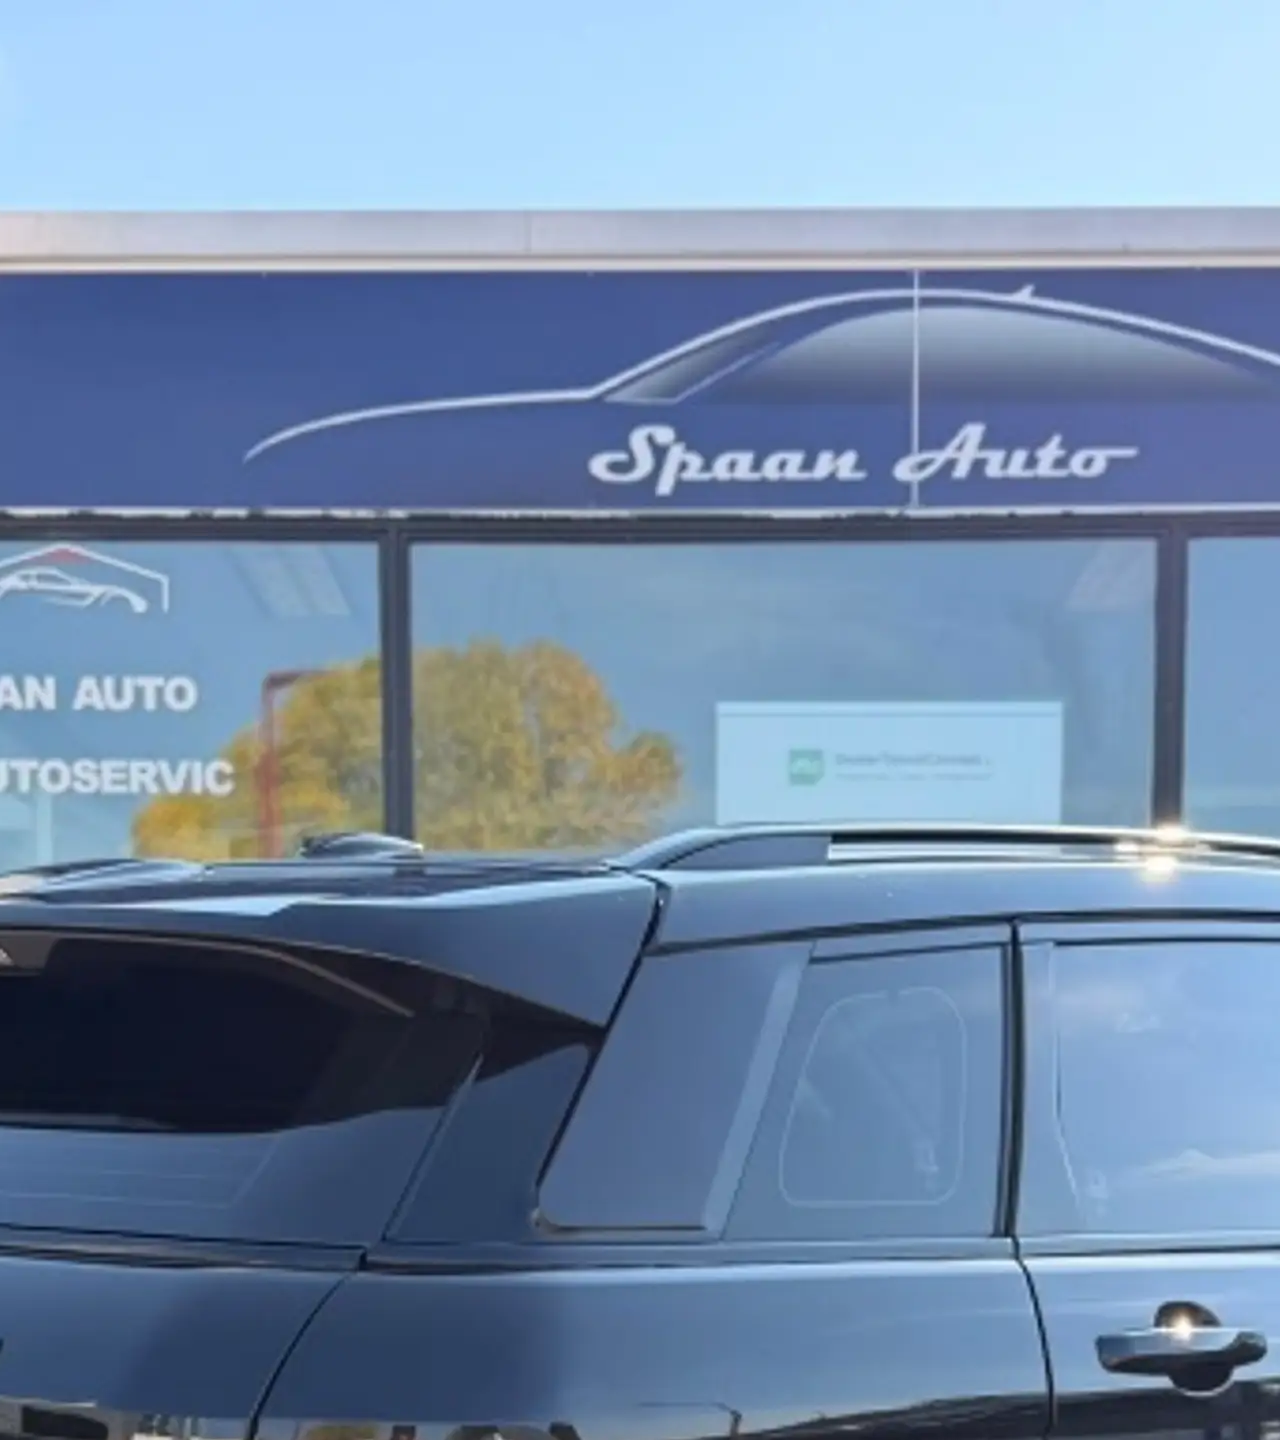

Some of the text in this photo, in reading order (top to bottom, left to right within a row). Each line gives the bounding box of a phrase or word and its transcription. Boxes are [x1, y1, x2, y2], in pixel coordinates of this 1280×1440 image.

[588, 421, 1139, 497] Spaan Auto
[72, 675, 199, 711] AUTO
